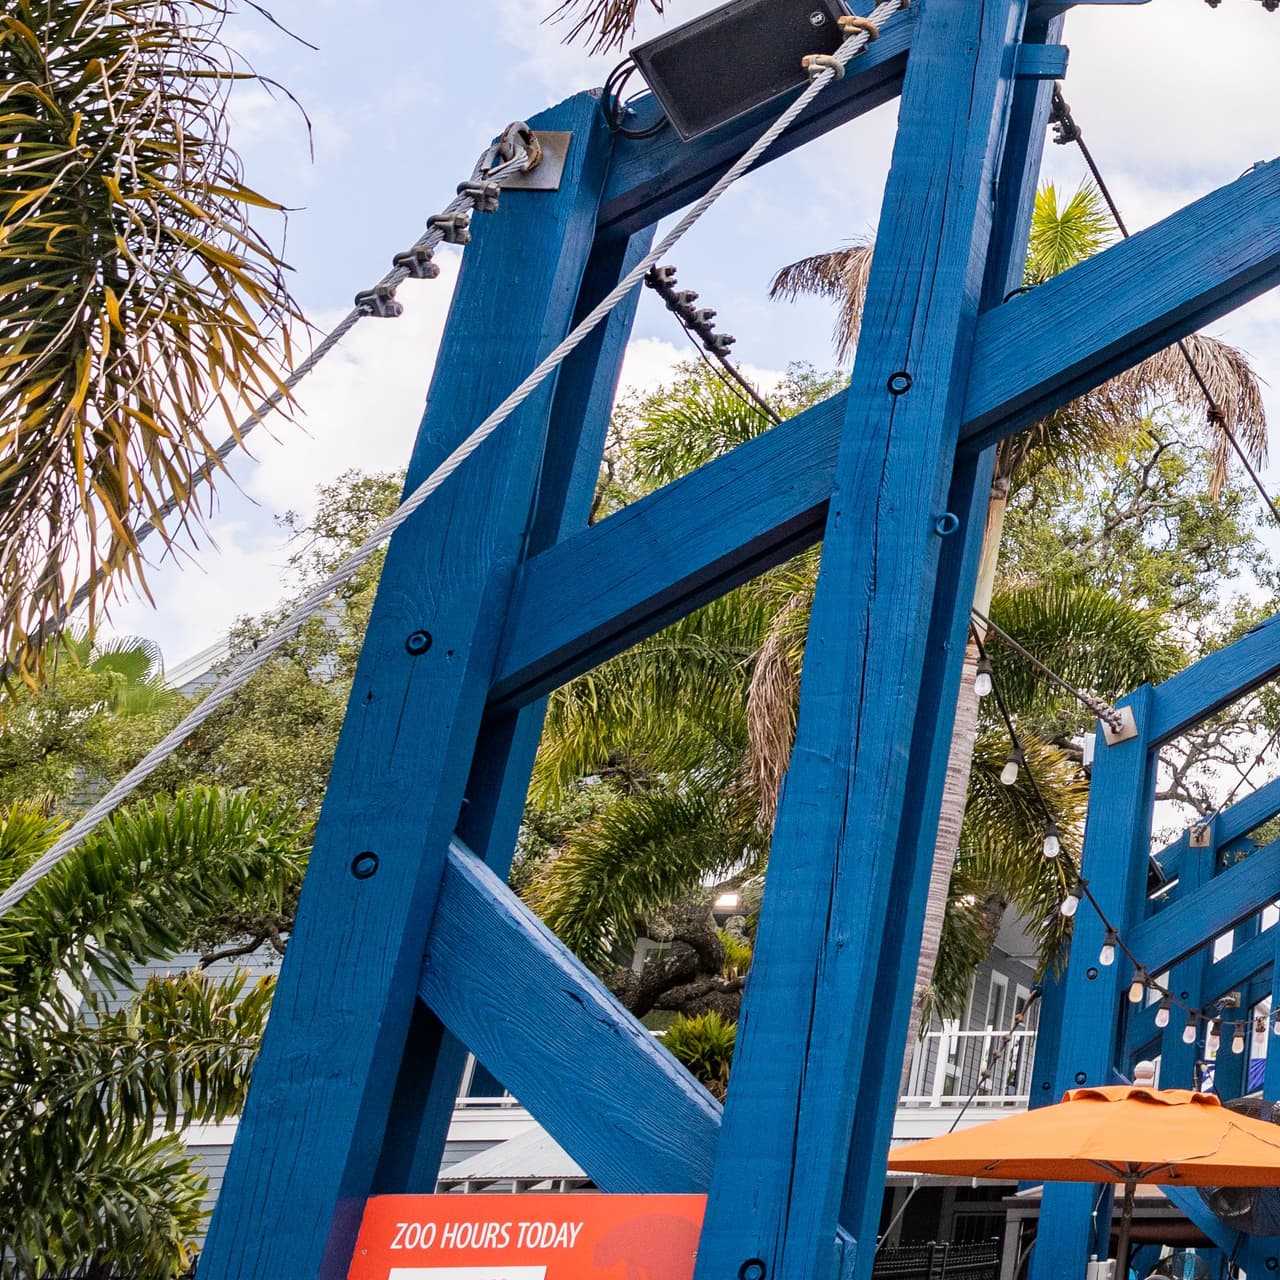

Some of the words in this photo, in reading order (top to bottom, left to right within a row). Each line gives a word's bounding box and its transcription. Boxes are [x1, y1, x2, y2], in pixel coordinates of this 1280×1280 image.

[390, 1222, 437, 1249] ZOO
[440, 1222, 513, 1249] HOURS
[517, 1221, 585, 1249] TODAY
